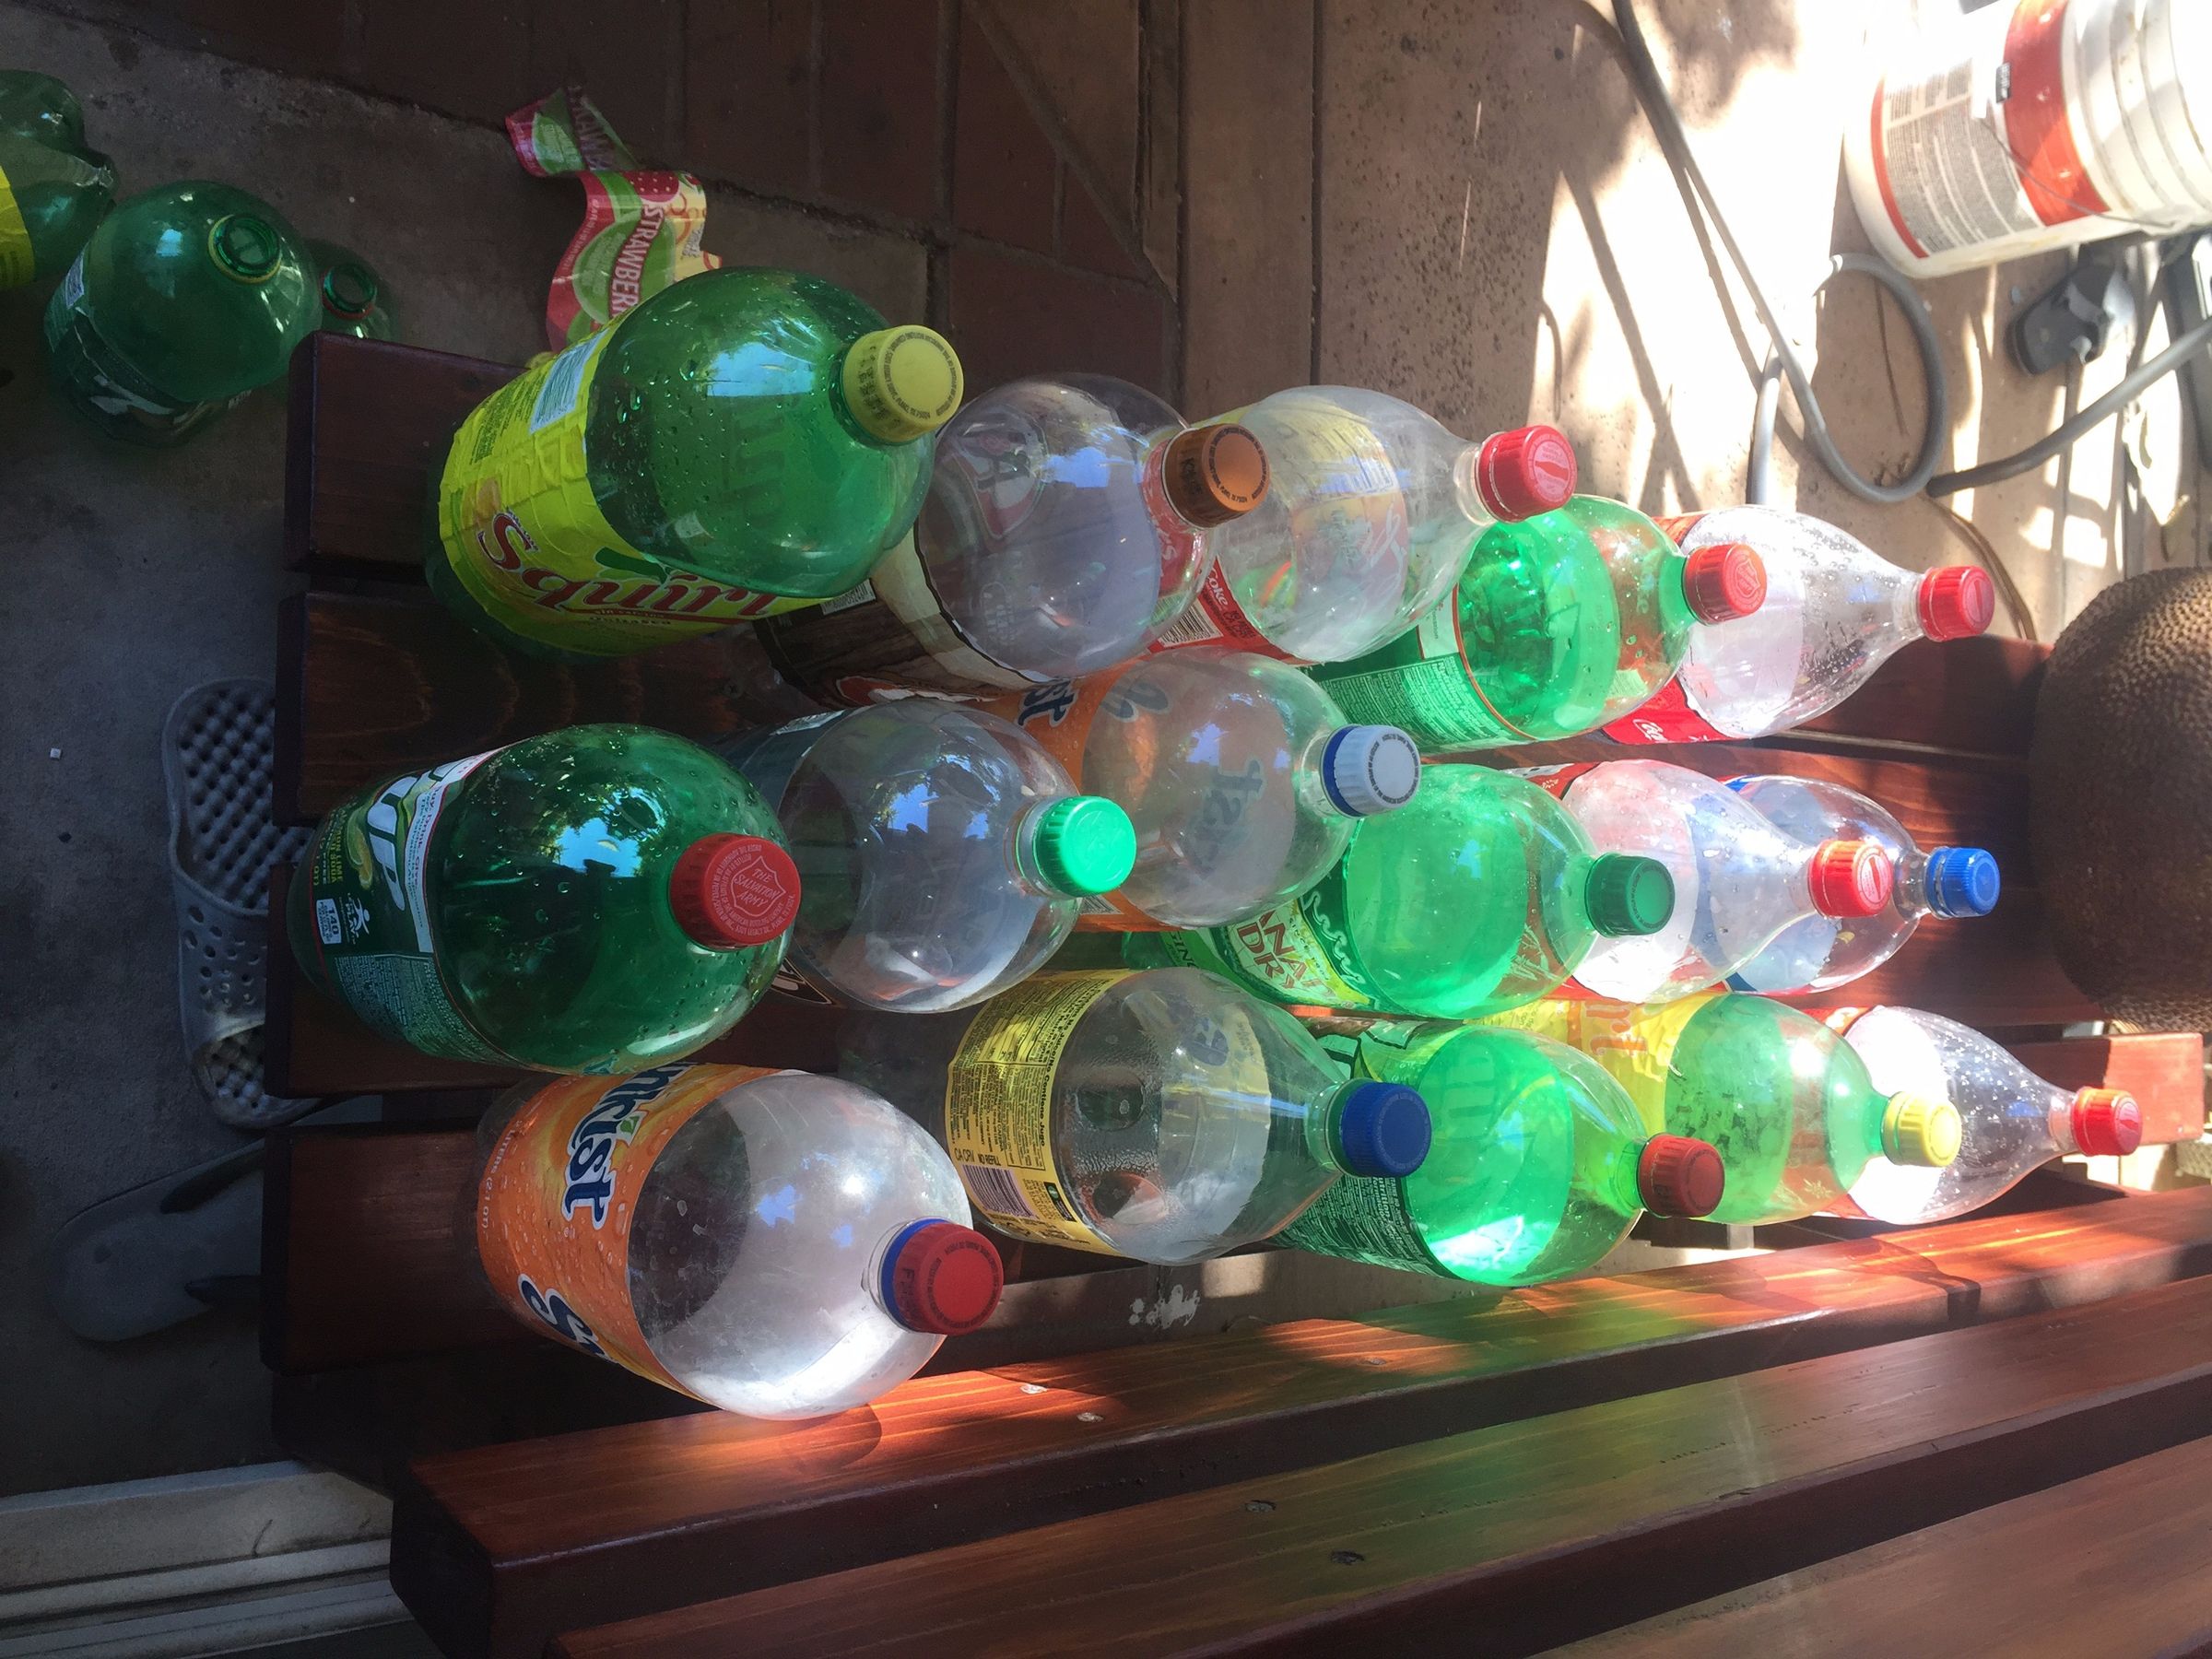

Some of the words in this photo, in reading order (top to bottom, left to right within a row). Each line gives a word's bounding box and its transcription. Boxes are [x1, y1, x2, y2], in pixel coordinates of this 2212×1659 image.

[477, 509, 778, 617] Squirt
[733, 874, 781, 900] SALVATION
[751, 867, 774, 883] THE
[736, 891, 769, 907] ARMY
[329, 909, 340, 935] 140
[1040, 1075, 1052, 1120] Contiene
[490, 1129, 516, 1174] LITERS
[954, 1147, 963, 1161] CA
[977, 1153, 985, 1165] NO
[1377, 1177, 1391, 1218] utrition
